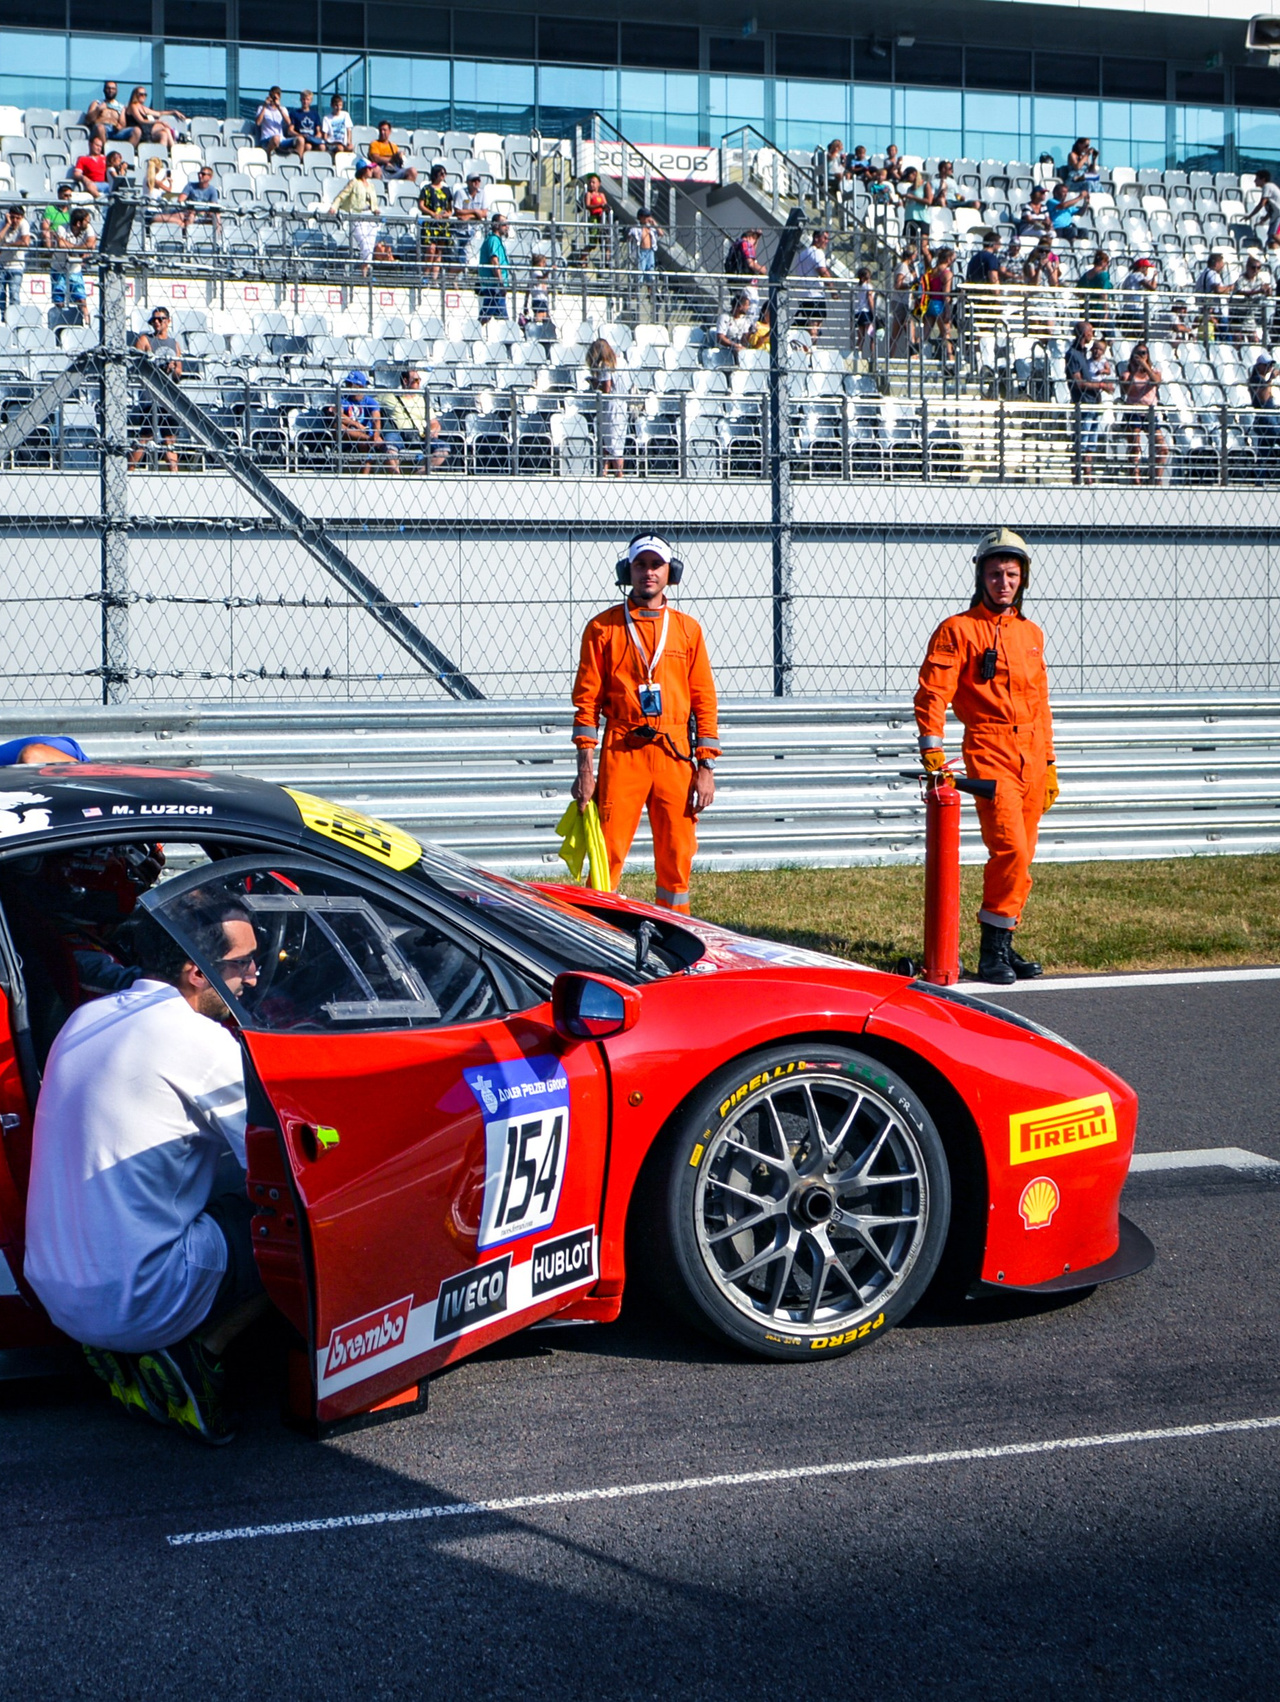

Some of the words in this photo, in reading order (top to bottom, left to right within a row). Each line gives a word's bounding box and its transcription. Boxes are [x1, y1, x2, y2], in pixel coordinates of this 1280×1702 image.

[659, 154, 708, 171] 206
[112, 805, 135, 815] M.
[140, 804, 213, 816] LUZICH
[720, 1062, 795, 1118] PIRELLI
[1020, 1105, 1108, 1153] PIRELLI
[494, 1114, 564, 1230] 154
[534, 1241, 591, 1284] HUBLOT
[441, 1270, 504, 1321] IVECO
[328, 1313, 405, 1372] brembo
